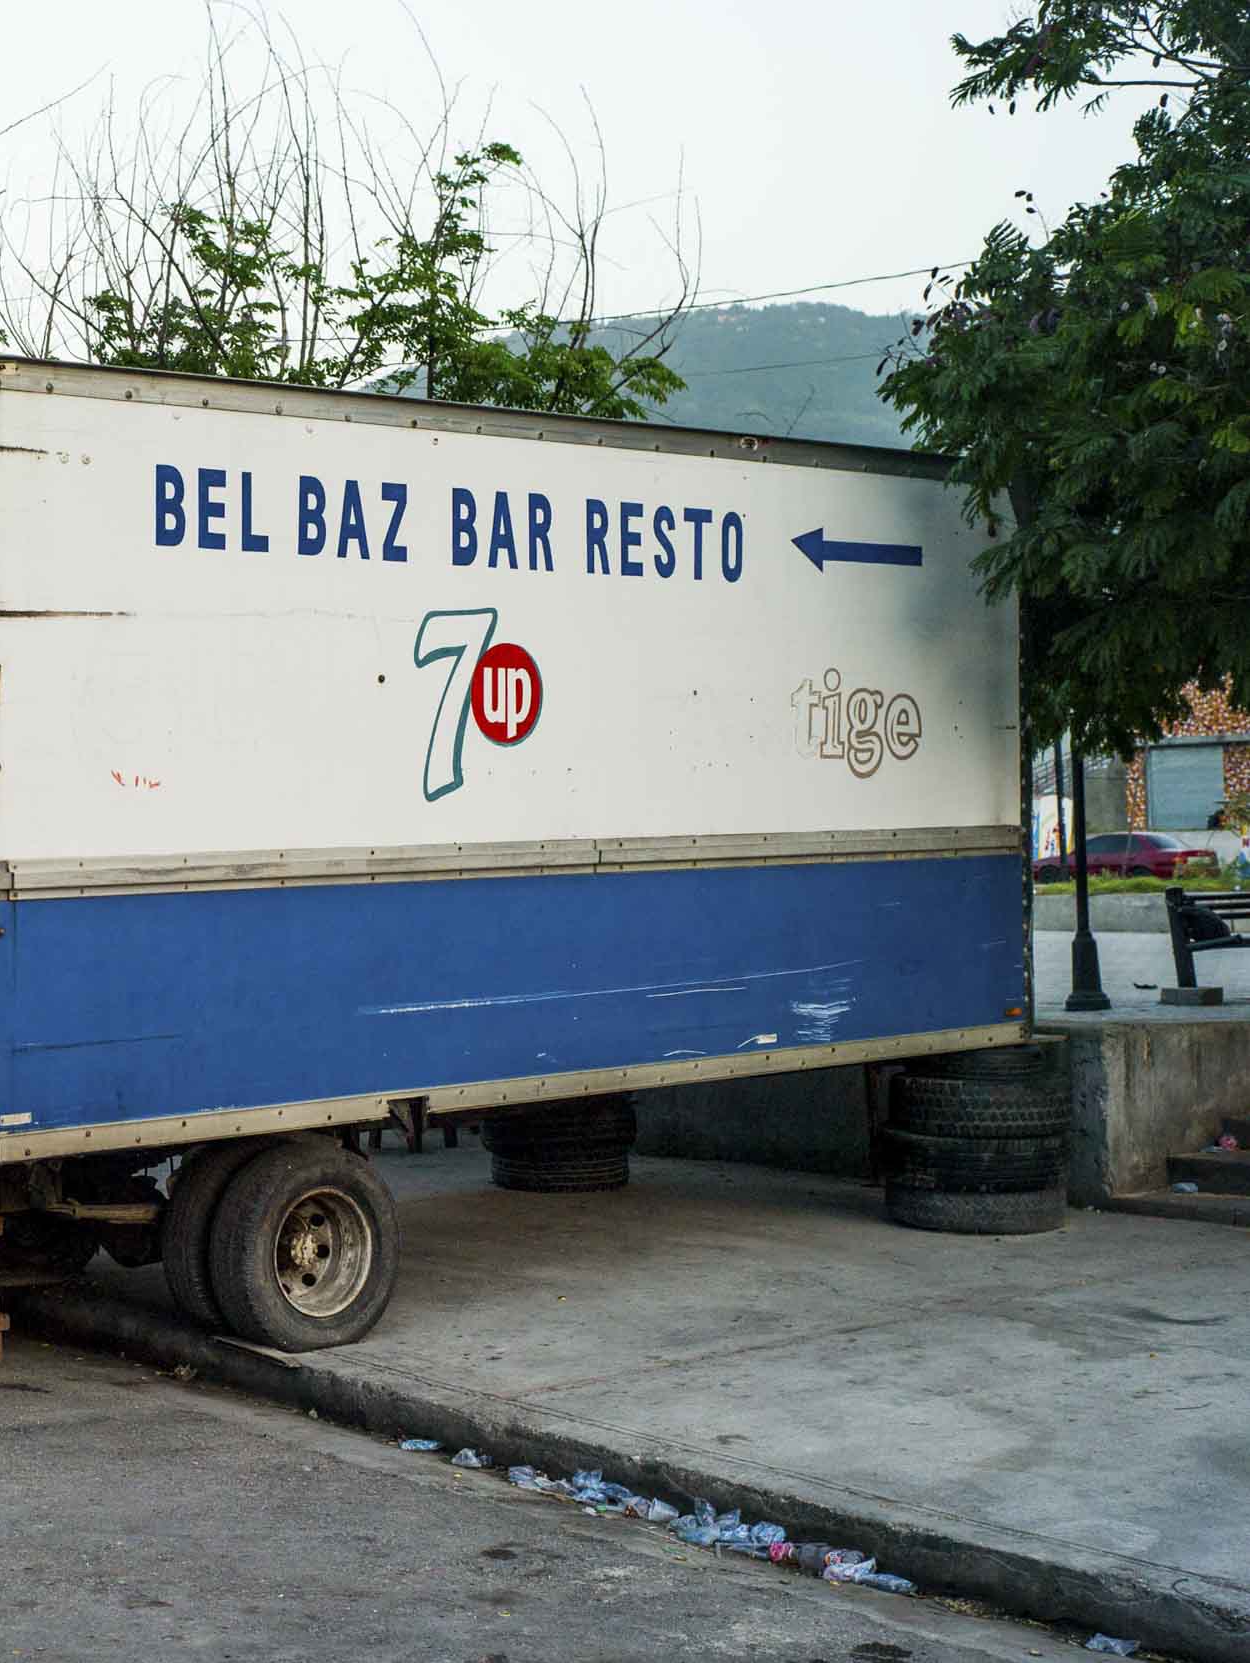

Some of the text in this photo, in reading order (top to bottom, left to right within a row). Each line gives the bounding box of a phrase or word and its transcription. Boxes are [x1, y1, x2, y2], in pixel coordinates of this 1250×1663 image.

[155, 463, 743, 583] BEL BAZ BAR RESTO
